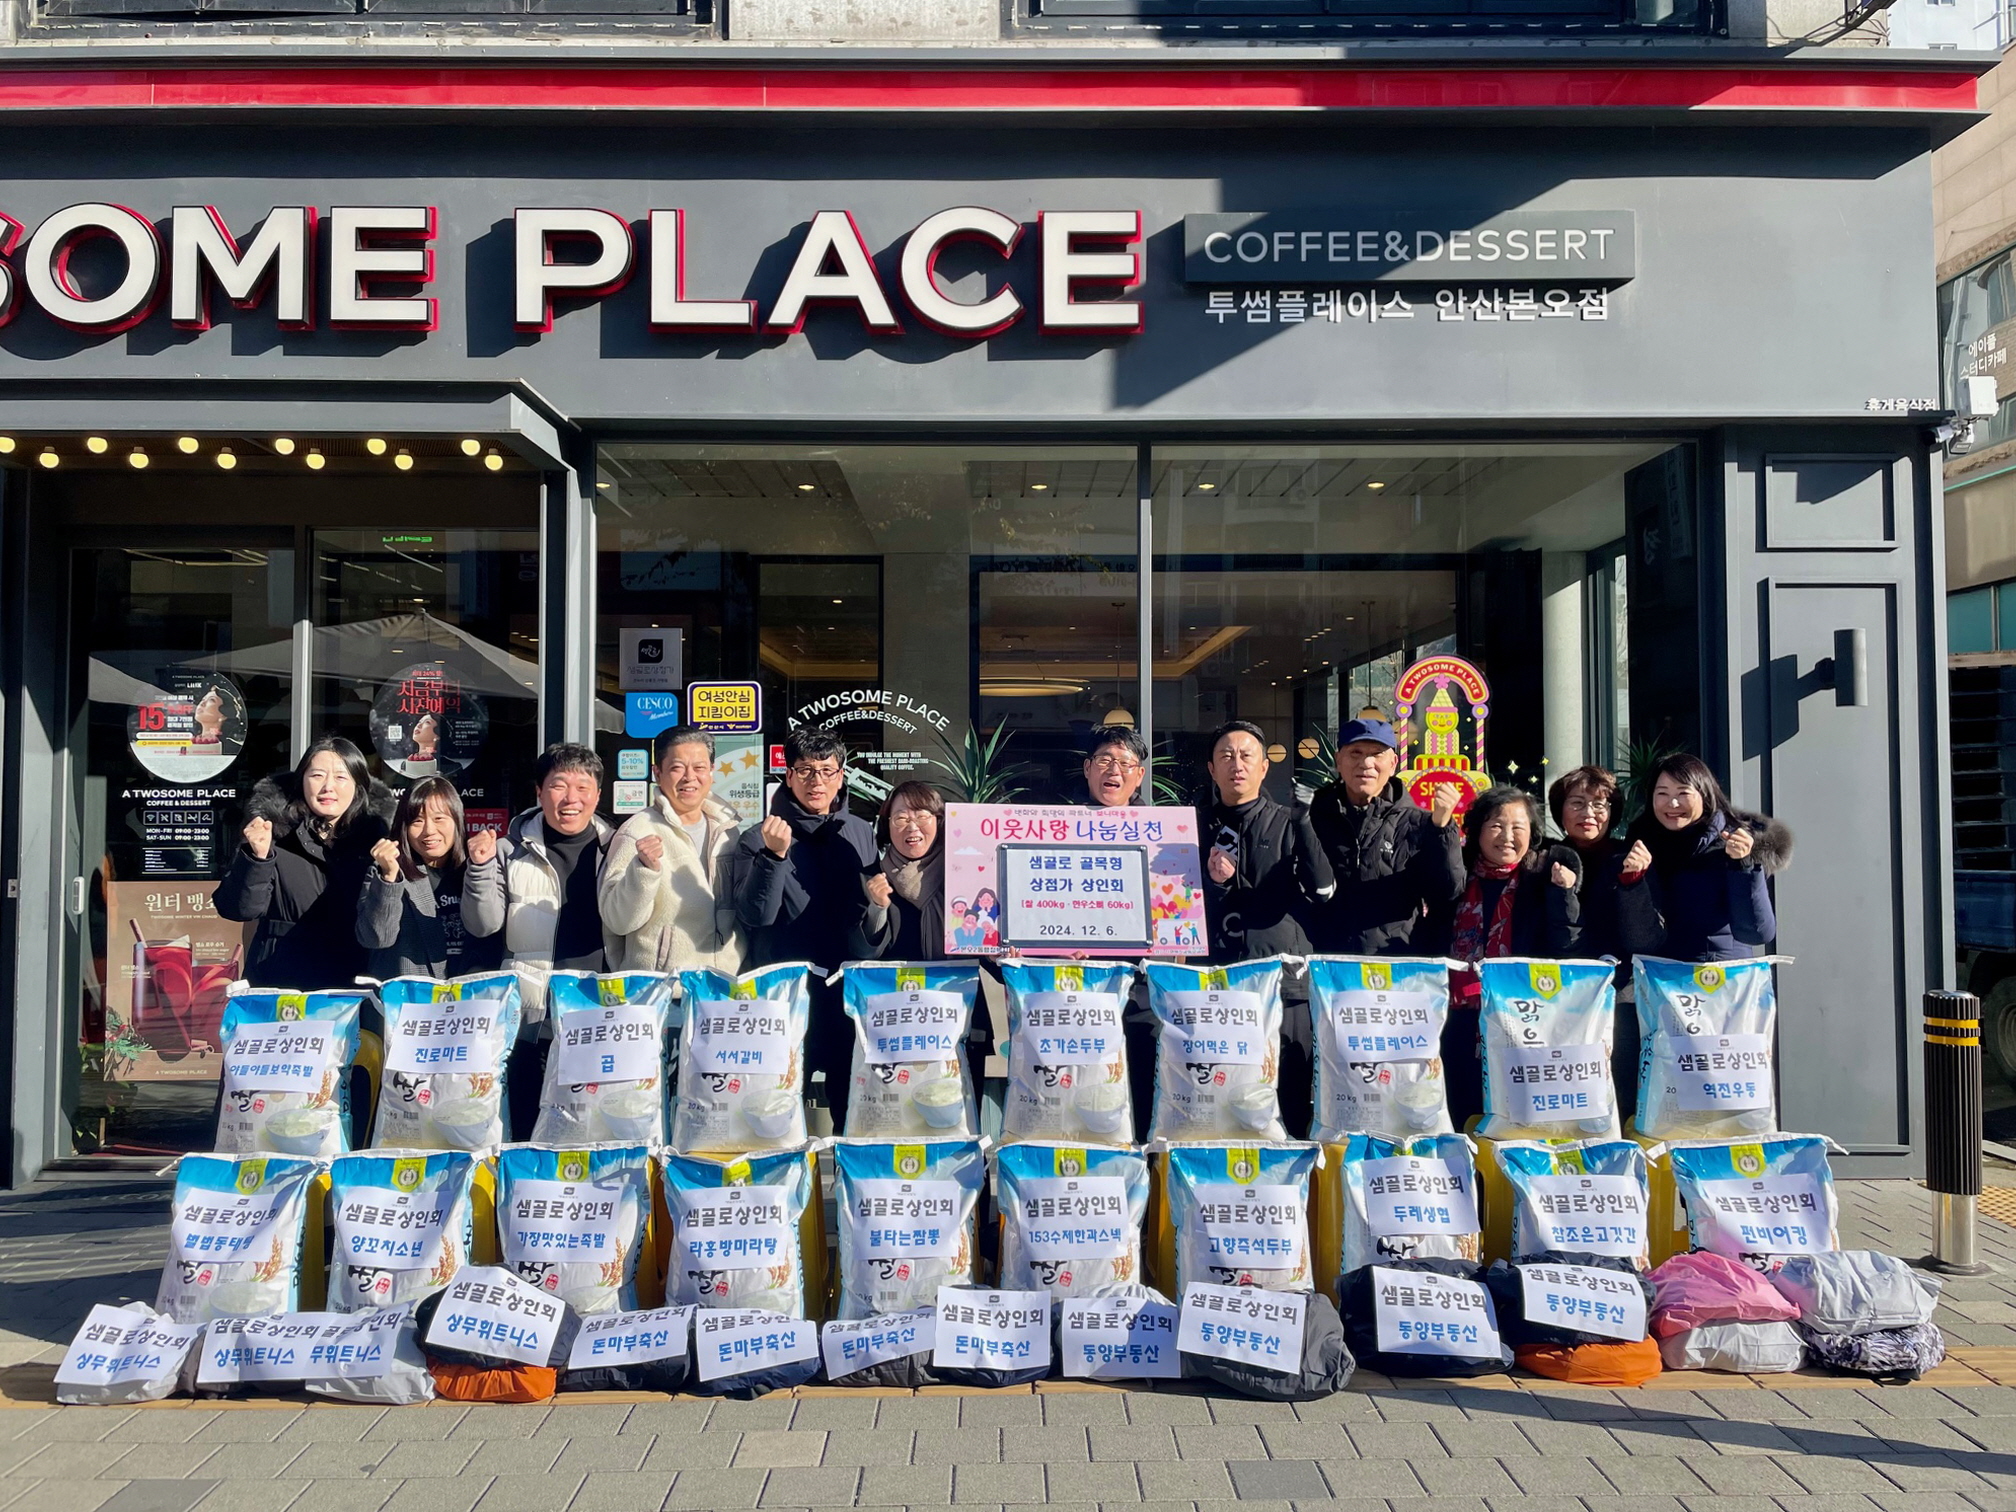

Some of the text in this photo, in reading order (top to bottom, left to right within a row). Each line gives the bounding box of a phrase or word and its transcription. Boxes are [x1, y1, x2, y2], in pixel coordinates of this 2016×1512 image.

[1204, 228, 1616, 263] COFFEE&DESSERT
[0, 203, 1144, 334] OME PLACE
[1204, 286, 1610, 323] 투썸플레이스 안산본오점
[1968, 333, 1997, 358] 에이플
[1960, 347, 2007, 380] 스터디카페
[1866, 397, 1937, 411] 휴게음식점
[1404, 663, 1480, 696] A TWOSOME PLACE
[637, 697, 673, 710] CESCO
[698, 690, 750, 703] 여성안심
[138, 702, 165, 730] 15
[698, 706, 750, 718] 지킴이집
[787, 689, 951, 731] A TWOSOME PLACE
[818, 709, 918, 735] COFFEE&DESSERT
[122, 789, 236, 798] A TWOSOME PLACE
[729, 790, 760, 798] 위생등급
[980, 818, 1164, 842] 이웃사랑 나눔실천
[1029, 856, 1123, 871] 샘골로 골목형
[1029, 877, 1124, 893] 상점가 상인회
[144, 892, 180, 912] 윈터
[1036, 901, 1065, 911] 400kg
[1039, 925, 1118, 936] 2024. 12. 6.
[402, 1016, 491, 1037] 샘골로상인회
[700, 1017, 786, 1036] 샘골로상인회
[871, 1006, 958, 1027] 샘골로상인회
[1026, 1009, 1116, 1027] 샘골로상인회
[1171, 1007, 1258, 1026] 샘골로상인회
[1338, 1007, 1429, 1026] 샘골로상인회
[565, 1023, 654, 1046] 샘골로상인회
[877, 1034, 952, 1053] 투썸플레이스
[1347, 1035, 1429, 1051] 투썸플레이스
[234, 1037, 324, 1055] 샘골로상인회
[414, 1046, 468, 1063] 진로마트
[1039, 1038, 1106, 1054] 초가손두부
[1182, 1040, 1248, 1055] 장어먹은 닭
[601, 1054, 615, 1073] 곱
[1510, 1060, 1602, 1084] 샘골로상인회
[1677, 1052, 1768, 1072] 샘골로상인회
[1336, 1093, 1357, 1103] 20 kg
[1666, 1086, 1677, 1094] 20
[1703, 1082, 1757, 1099] 역전우동
[1532, 1092, 1588, 1111] 진로마트
[1369, 1174, 1465, 1195] 샘골로상인회
[516, 1199, 614, 1222] 샘골로상인회
[858, 1197, 953, 1218] 샘골로상인회
[1025, 1196, 1122, 1218] 샘골로상인회
[1394, 1205, 1451, 1223] 두레생협
[1538, 1194, 1640, 1214] 샘골로상인회
[1715, 1193, 1817, 1214] 샘골로상인회
[184, 1205, 279, 1226] 샘골로상인회
[345, 1203, 443, 1229] 샘골로상인회
[685, 1205, 783, 1228] 샘골로상인회
[1200, 1204, 1297, 1225] 샘골로상인회
[517, 1231, 607, 1248] 가장맛있는족발
[870, 1229, 940, 1247] 불타는짬뽕
[1552, 1226, 1637, 1244] 참조은고깃간
[1740, 1224, 1808, 1246] 펀비어킹
[351, 1235, 424, 1257] 양꼬치소년
[1208, 1237, 1293, 1256] 고향즉석두부
[1526, 1268, 1637, 1296] 샘골로상인회
[452, 1281, 557, 1323] 샘골로상인회
[1380, 1284, 1487, 1312] 샘골로상인회
[585, 1306, 688, 1333] 샘골로상인회
[942, 1303, 1044, 1329] 샘골로상인회
[1189, 1292, 1298, 1326] 샘골로상인회
[1546, 1293, 1626, 1325] 동양부동산
[214, 1318, 321, 1339] 샘골로상인회
[446, 1313, 539, 1350] 상무휘트니스
[701, 1315, 808, 1333] 샘골로상인
[829, 1313, 930, 1333] 샘골로상인회
[1068, 1311, 1173, 1333] 샘골로상인회
[1398, 1320, 1478, 1344] 동양부동산
[85, 1322, 191, 1350] 샘골로상인회
[591, 1330, 669, 1355] 돈마부축산
[718, 1330, 796, 1362] 돈마부축산
[842, 1327, 916, 1360] 돈마부축산
[955, 1335, 1031, 1358] 돈마부축산
[1200, 1322, 1282, 1355] 동양부동산
[76, 1352, 161, 1374] 상무휘트니스
[214, 1347, 295, 1368] 상무휘트니스
[1083, 1344, 1160, 1364] 동양부동산
